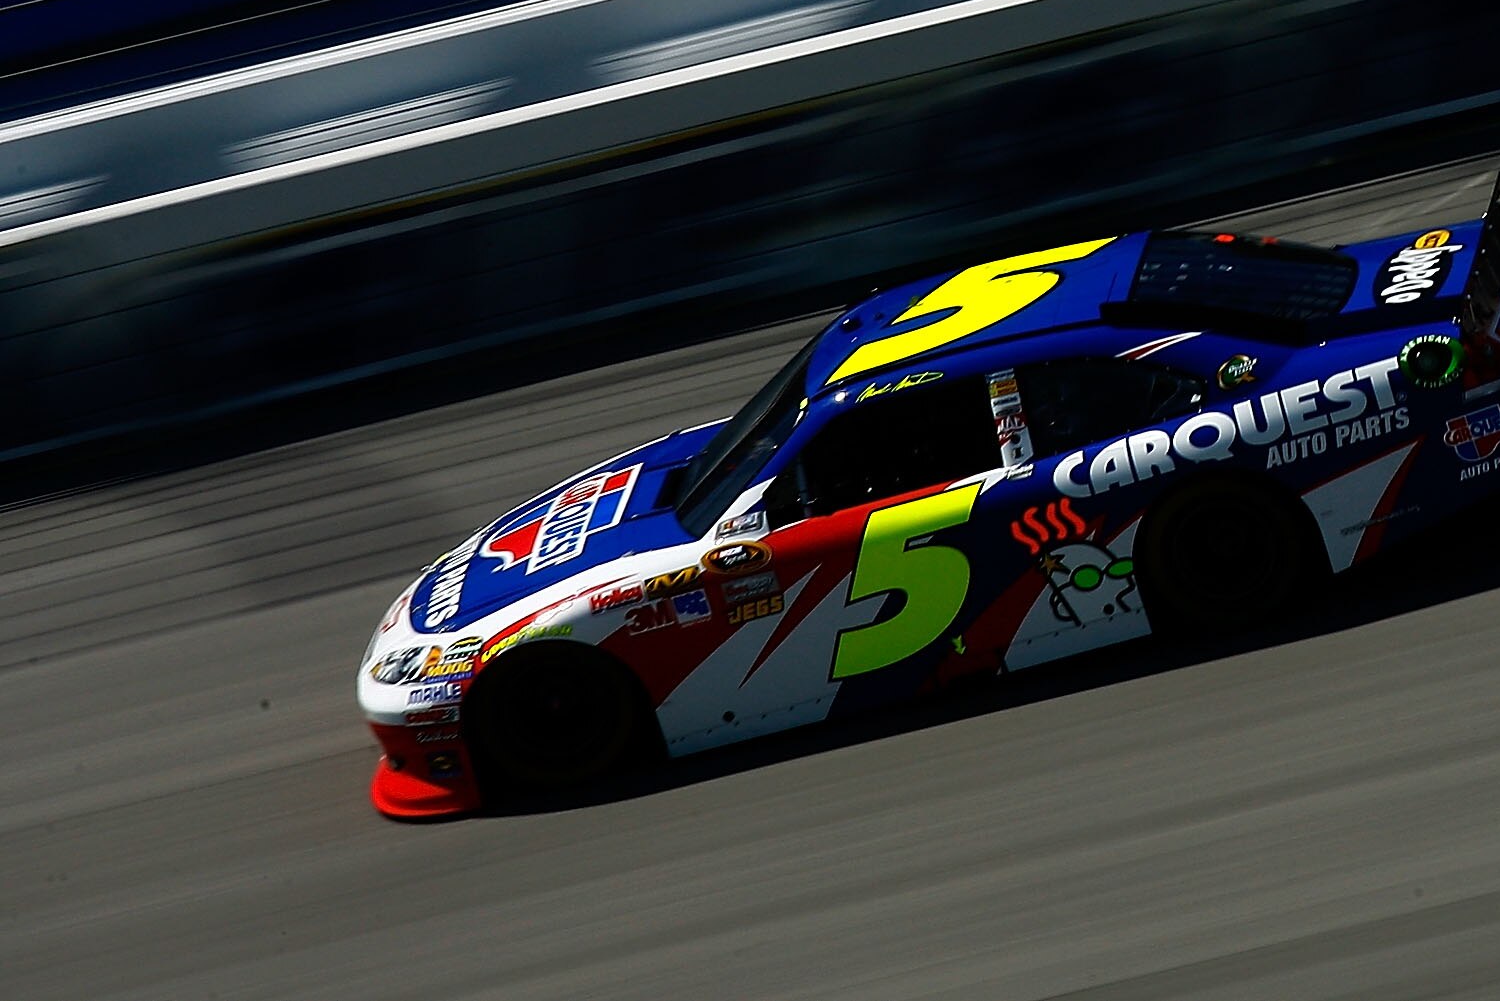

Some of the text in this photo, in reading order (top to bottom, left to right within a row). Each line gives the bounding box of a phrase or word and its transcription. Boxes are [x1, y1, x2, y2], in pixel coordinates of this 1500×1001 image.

[825, 236, 1119, 386] 5
[1053, 356, 1400, 499] CARQUEST
[1266, 407, 1410, 470] AUTO PARTS
[1460, 461, 1491, 481] AUTO
[591, 585, 643, 612] Holley
[831, 480, 983, 683] 5
[625, 599, 675, 634] 3M
[728, 594, 785, 625] JEGS
[408, 684, 463, 703] MAHLE
